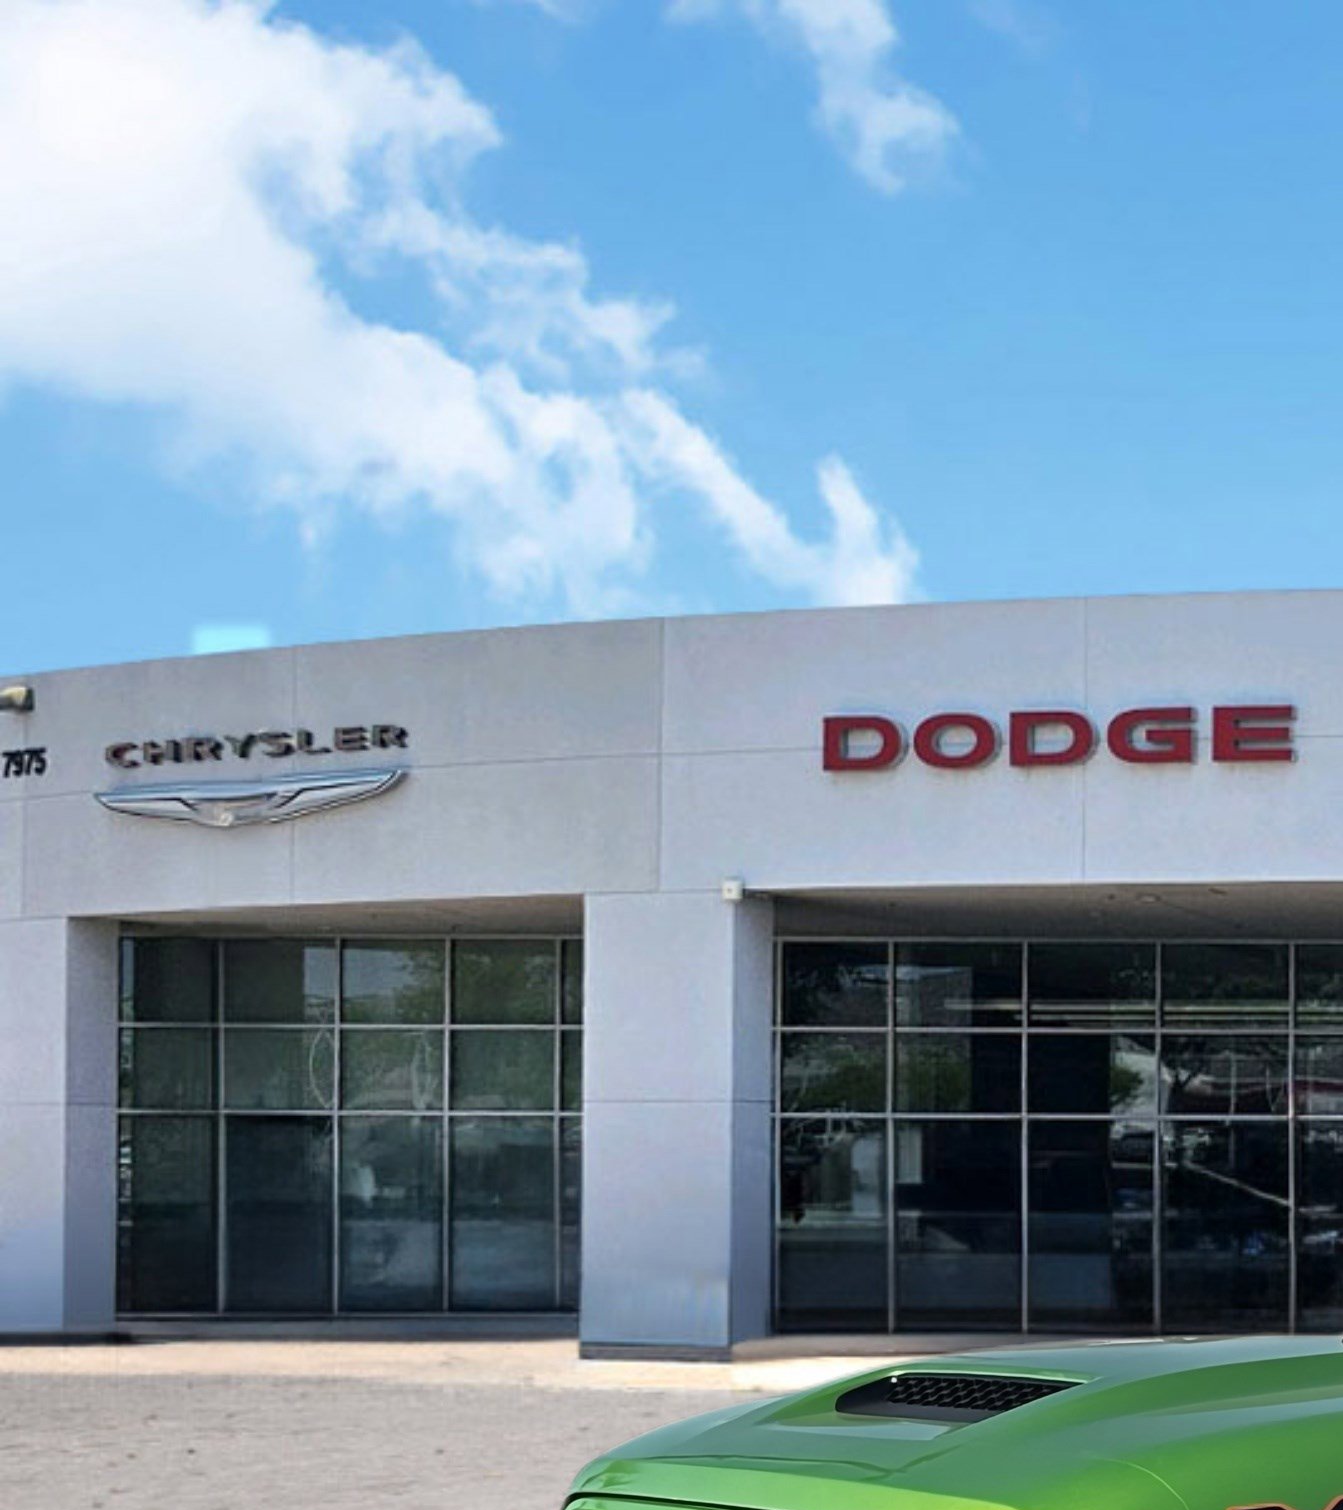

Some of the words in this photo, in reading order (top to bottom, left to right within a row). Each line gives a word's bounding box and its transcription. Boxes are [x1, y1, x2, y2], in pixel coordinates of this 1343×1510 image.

[105, 724, 409, 768] CHRYSLER
[823, 705, 1298, 771] DODGE
[2, 748, 47, 778] 7975
